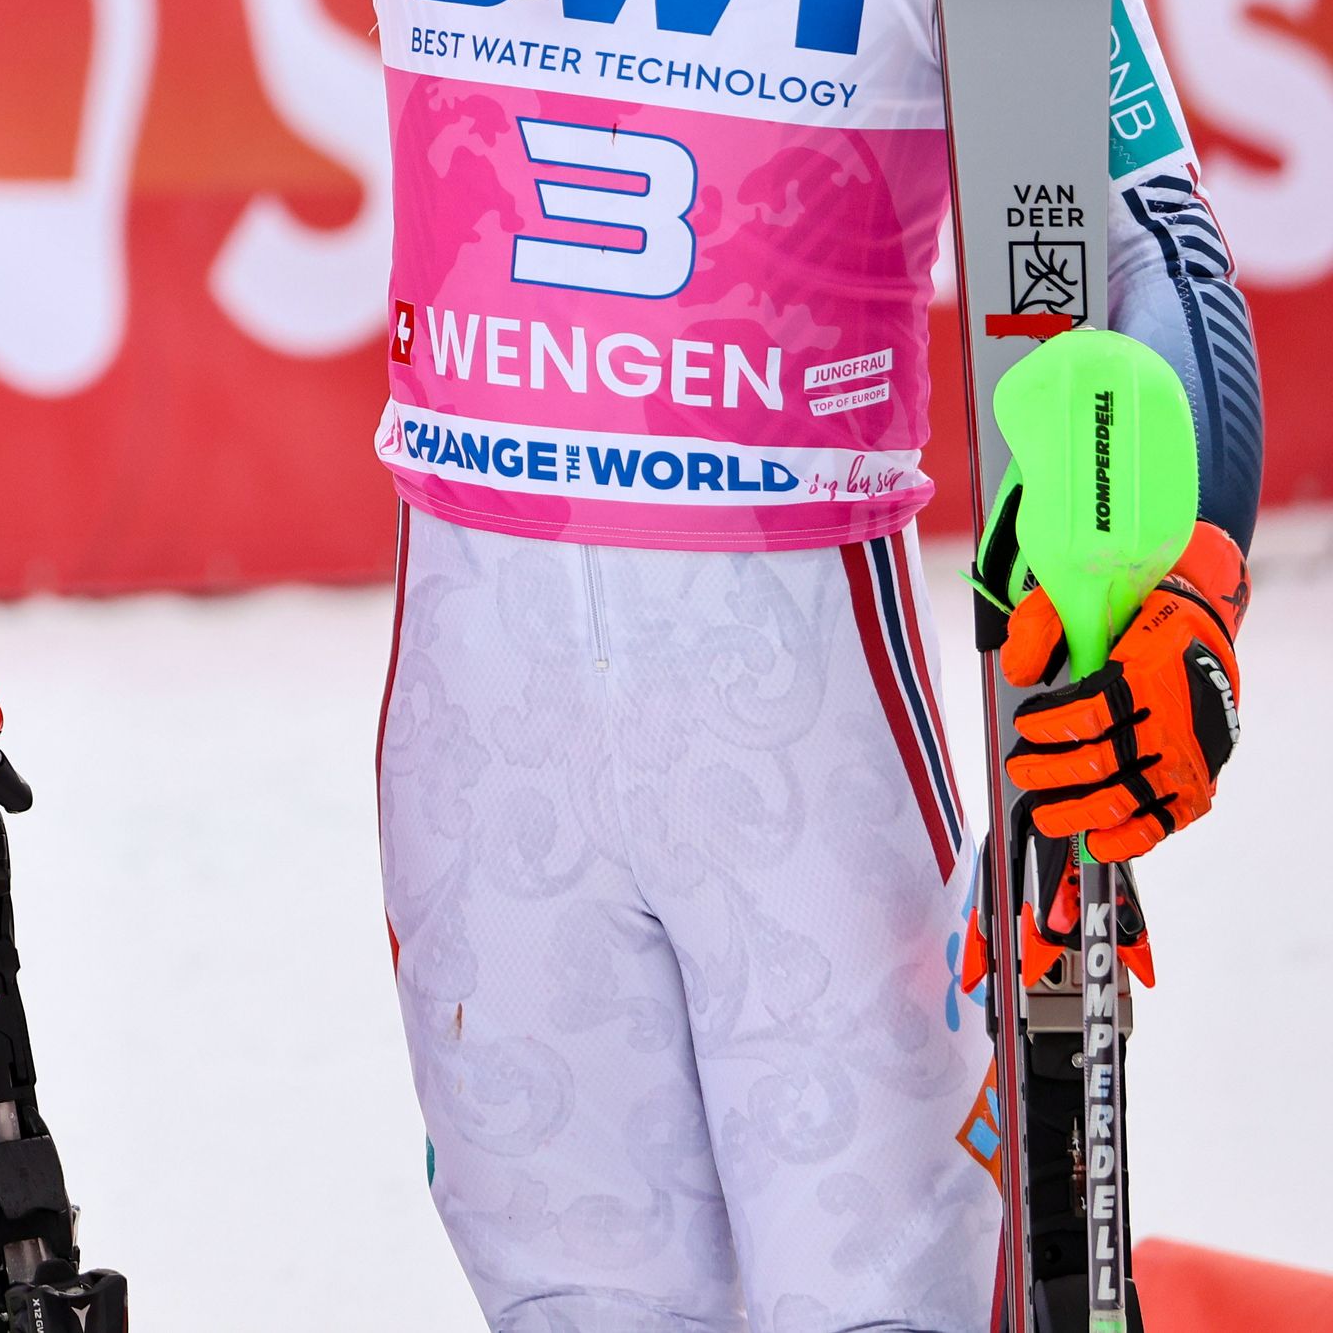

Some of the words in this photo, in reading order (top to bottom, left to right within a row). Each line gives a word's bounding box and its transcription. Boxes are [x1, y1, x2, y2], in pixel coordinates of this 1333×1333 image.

[411, 27, 465, 59] BEST
[473, 34, 582, 75] WATER
[595, 50, 858, 109] TECHNOLOGY
[510, 115, 699, 300] 3
[1007, 207, 1085, 229] DEER
[1013, 184, 1075, 205] VAN
[426, 306, 784, 411] WENGEN
[813, 354, 886, 384] JUNGFRAU
[814, 401, 833, 412] TOP
[836, 397, 849, 408] OF
[852, 388, 886, 405] EUROPE
[403, 418, 558, 483] CHANGE
[566, 444, 581, 483] THE
[587, 445, 800, 494] WORLD
[1095, 390, 1111, 533] KOMPERDELL
[1084, 902, 1117, 1302] KOMPERDELL
